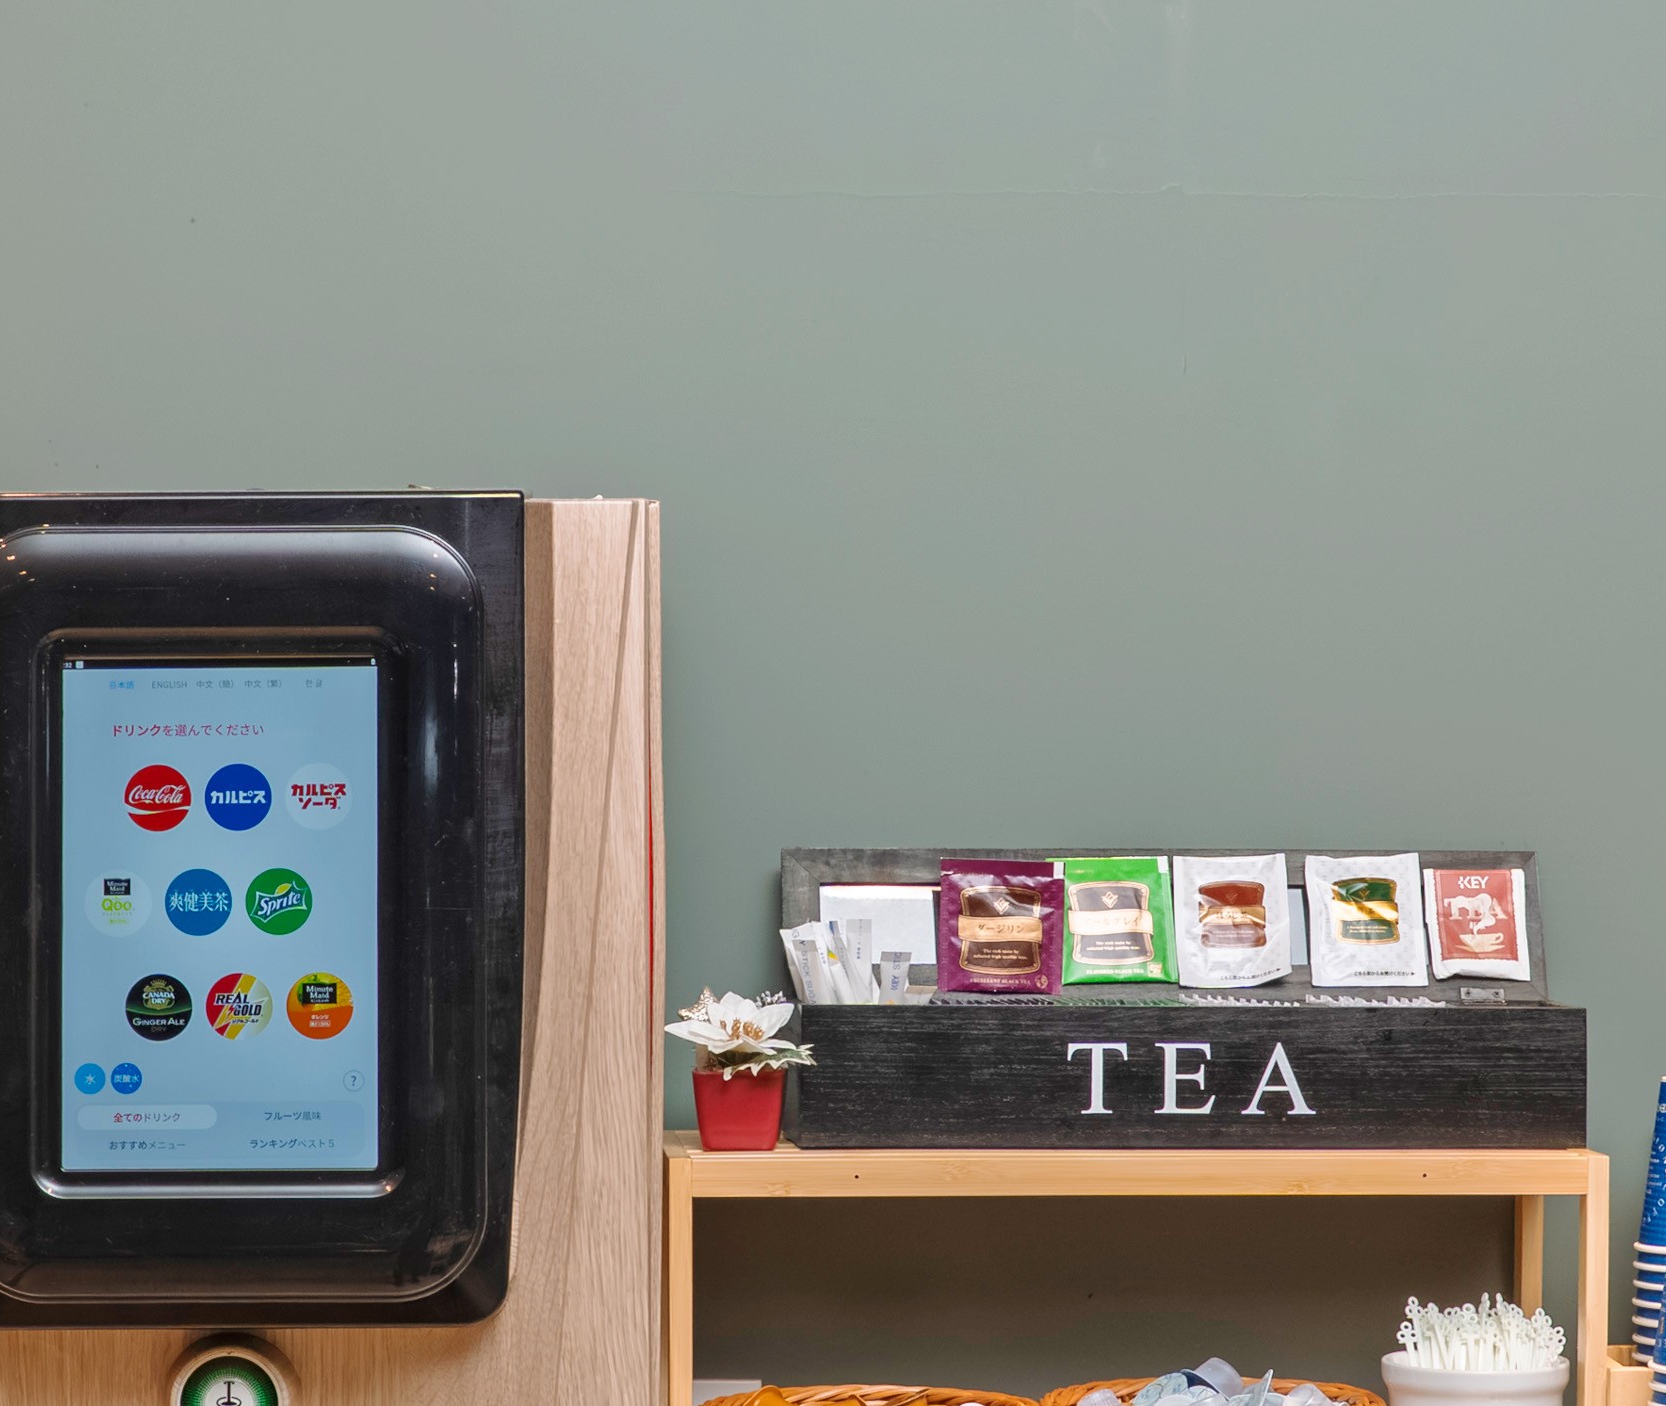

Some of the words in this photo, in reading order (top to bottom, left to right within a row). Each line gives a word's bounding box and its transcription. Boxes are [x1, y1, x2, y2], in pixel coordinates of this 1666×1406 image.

[109, 680, 135, 690] 日本語
[151, 681, 188, 689] ENGLISH
[113, 724, 264, 737] ドリンクを選んでください
[128, 784, 186, 805] Coca-Cola
[210, 790, 267, 804] カルピス
[290, 783, 347, 798] カルピス
[298, 796, 340, 810] ソーダ
[1458, 876, 1489, 889] KEY
[101, 898, 132, 912] Qoo
[169, 890, 229, 912] 爽健美茶
[257, 889, 302, 916] Sprite
[978, 924, 1025, 934] ダージリン
[142, 991, 176, 999] CANADA
[805, 977, 817, 1005] SUGA
[215, 991, 250, 1005] REAL
[233, 1004, 263, 1016] GOLD
[167, 1017, 186, 1026] ALE
[85, 1073, 96, 1085] 水
[1066, 1041, 1317, 1115] TEA
[113, 1111, 181, 1123] 全てのドリンク
[263, 1110, 322, 1122] フルーツ風味
[109, 1140, 186, 1150] おすすめメニュー
